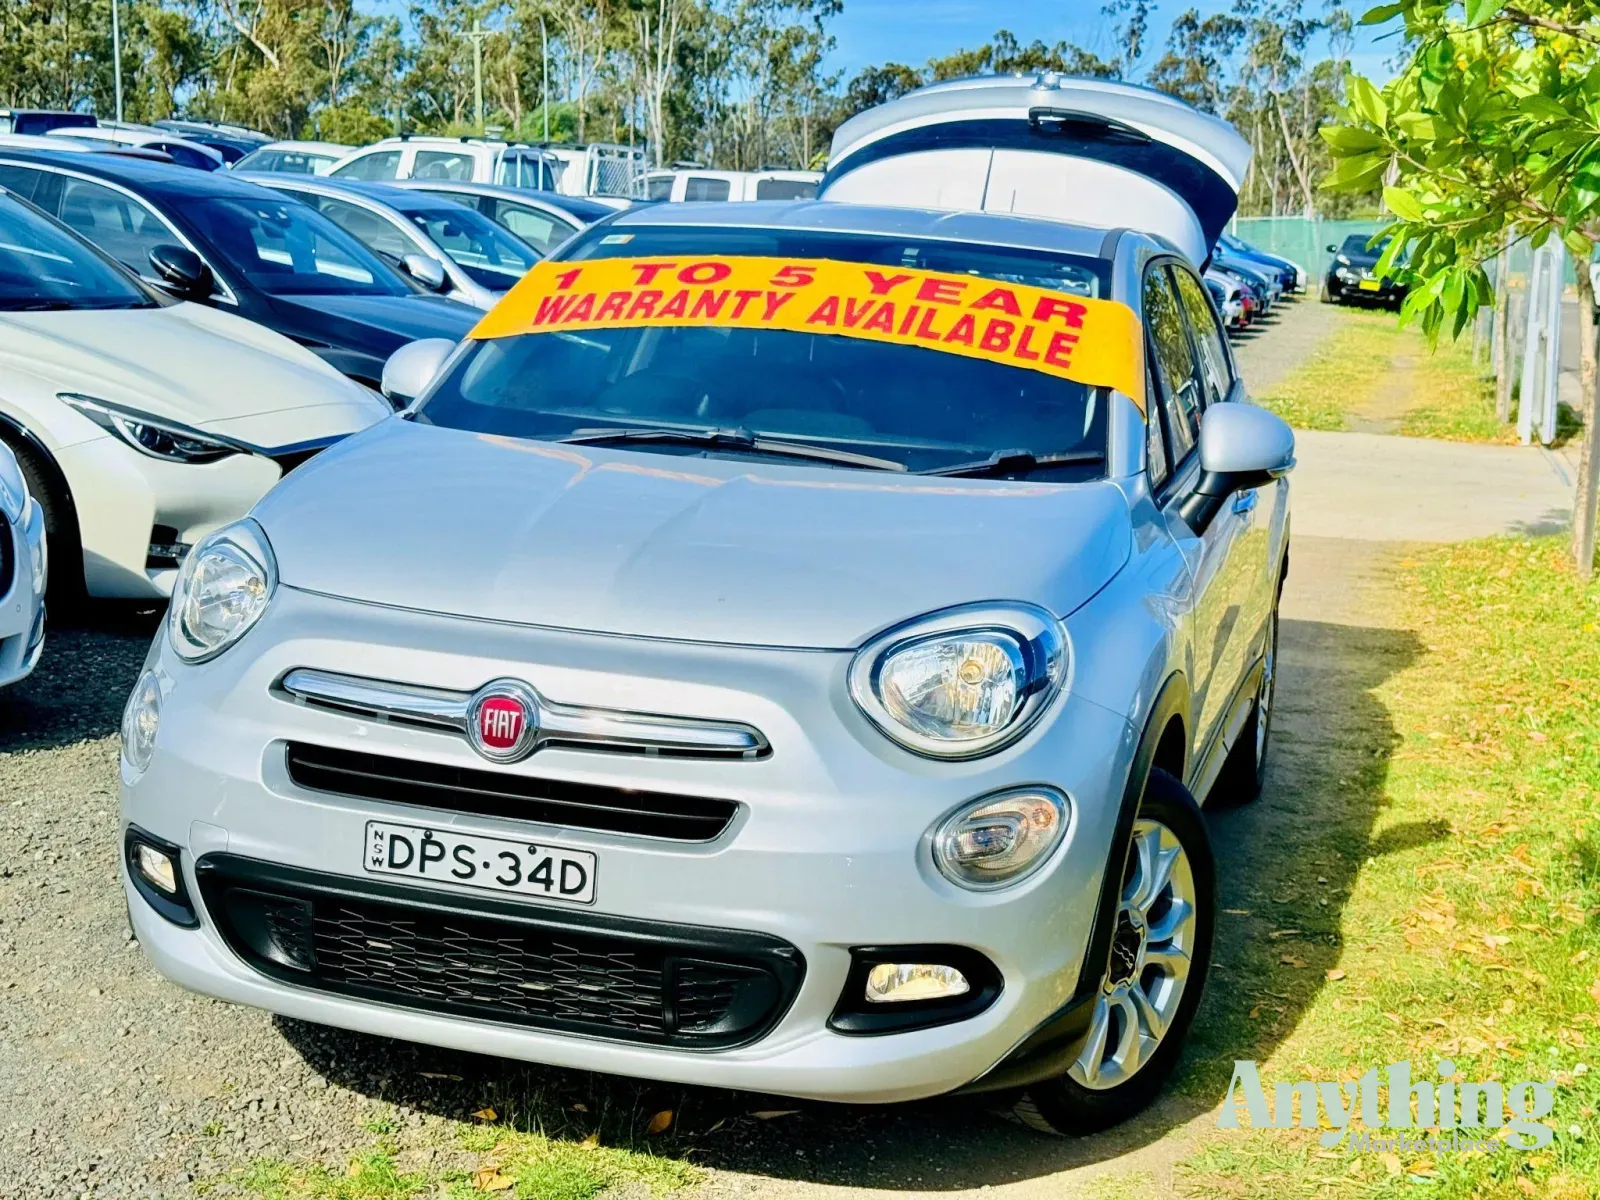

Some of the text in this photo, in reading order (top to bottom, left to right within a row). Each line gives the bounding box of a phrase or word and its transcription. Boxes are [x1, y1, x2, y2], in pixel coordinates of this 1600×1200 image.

[532, 288, 1080, 370] WARRANTY AVAILABLE
[555, 262, 1088, 329] 1 TO 5 YEAR
[484, 708, 520, 740] FIAT
